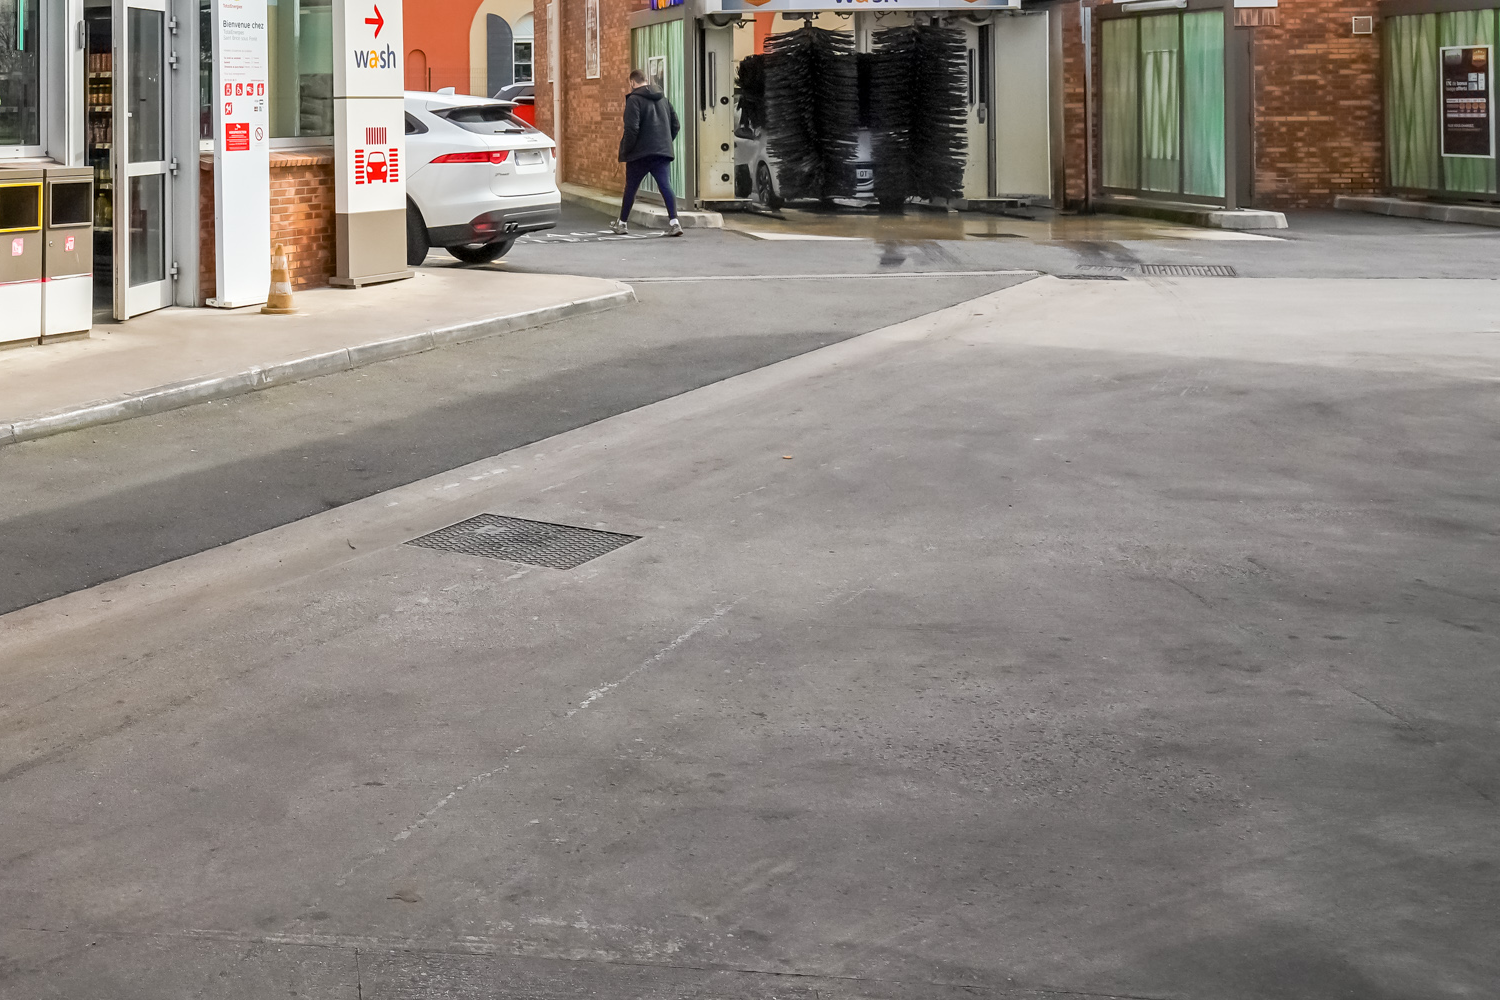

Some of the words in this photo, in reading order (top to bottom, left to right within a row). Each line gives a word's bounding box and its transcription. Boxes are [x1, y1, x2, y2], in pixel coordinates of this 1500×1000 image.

[222, 20, 250, 28] Bienvenue
[251, 21, 264, 29] chez
[353, 43, 396, 69] wash
